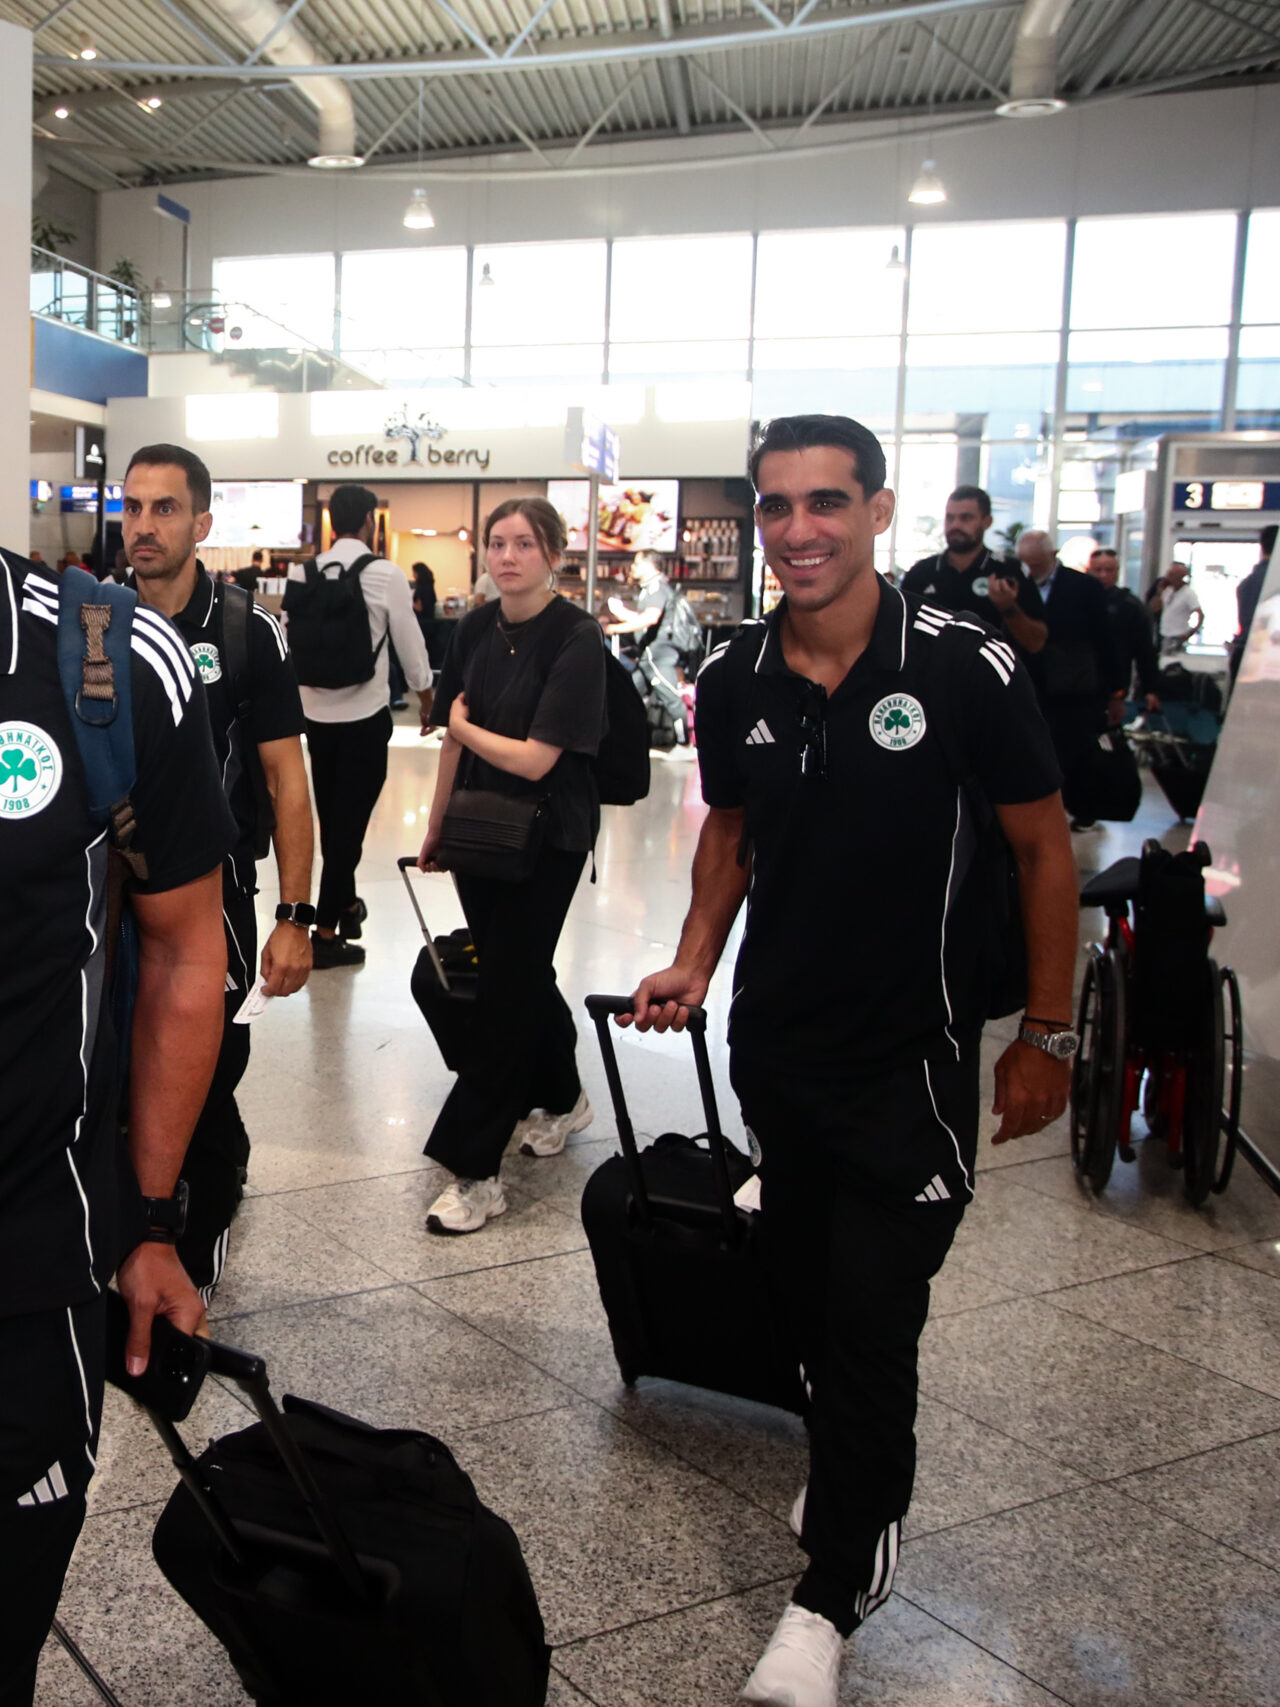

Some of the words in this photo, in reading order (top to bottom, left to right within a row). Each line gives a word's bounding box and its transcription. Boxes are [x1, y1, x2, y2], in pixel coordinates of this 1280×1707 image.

[327, 444, 399, 466] coffee
[427, 444, 491, 471] berry
[1184, 482, 1204, 509] 3
[3, 797, 30, 811] 1908
